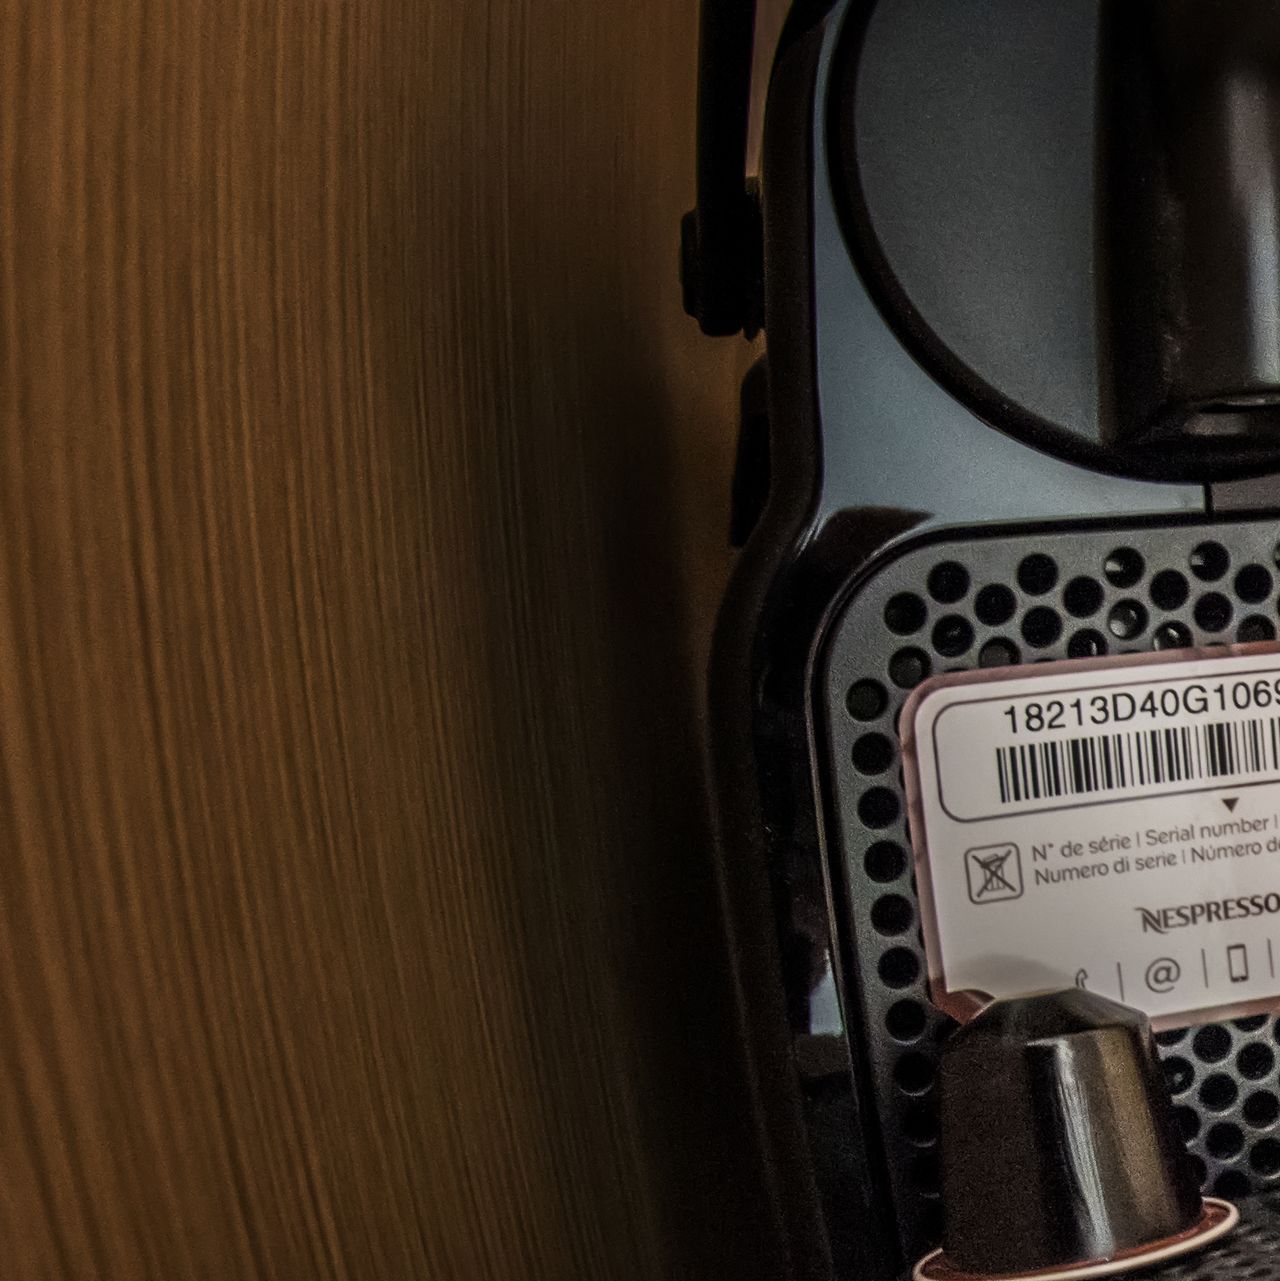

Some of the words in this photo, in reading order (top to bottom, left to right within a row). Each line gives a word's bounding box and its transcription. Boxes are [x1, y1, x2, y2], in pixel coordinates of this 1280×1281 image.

[1060, 841, 1085, 859] de
[1088, 833, 1132, 856] série
[1145, 824, 1195, 847] Serial
[1200, 814, 1270, 839] number
[1035, 862, 1110, 886] Numero
[1113, 856, 1131, 874] di
[1135, 851, 1178, 872] serie
[1191, 840, 1263, 864] Número
